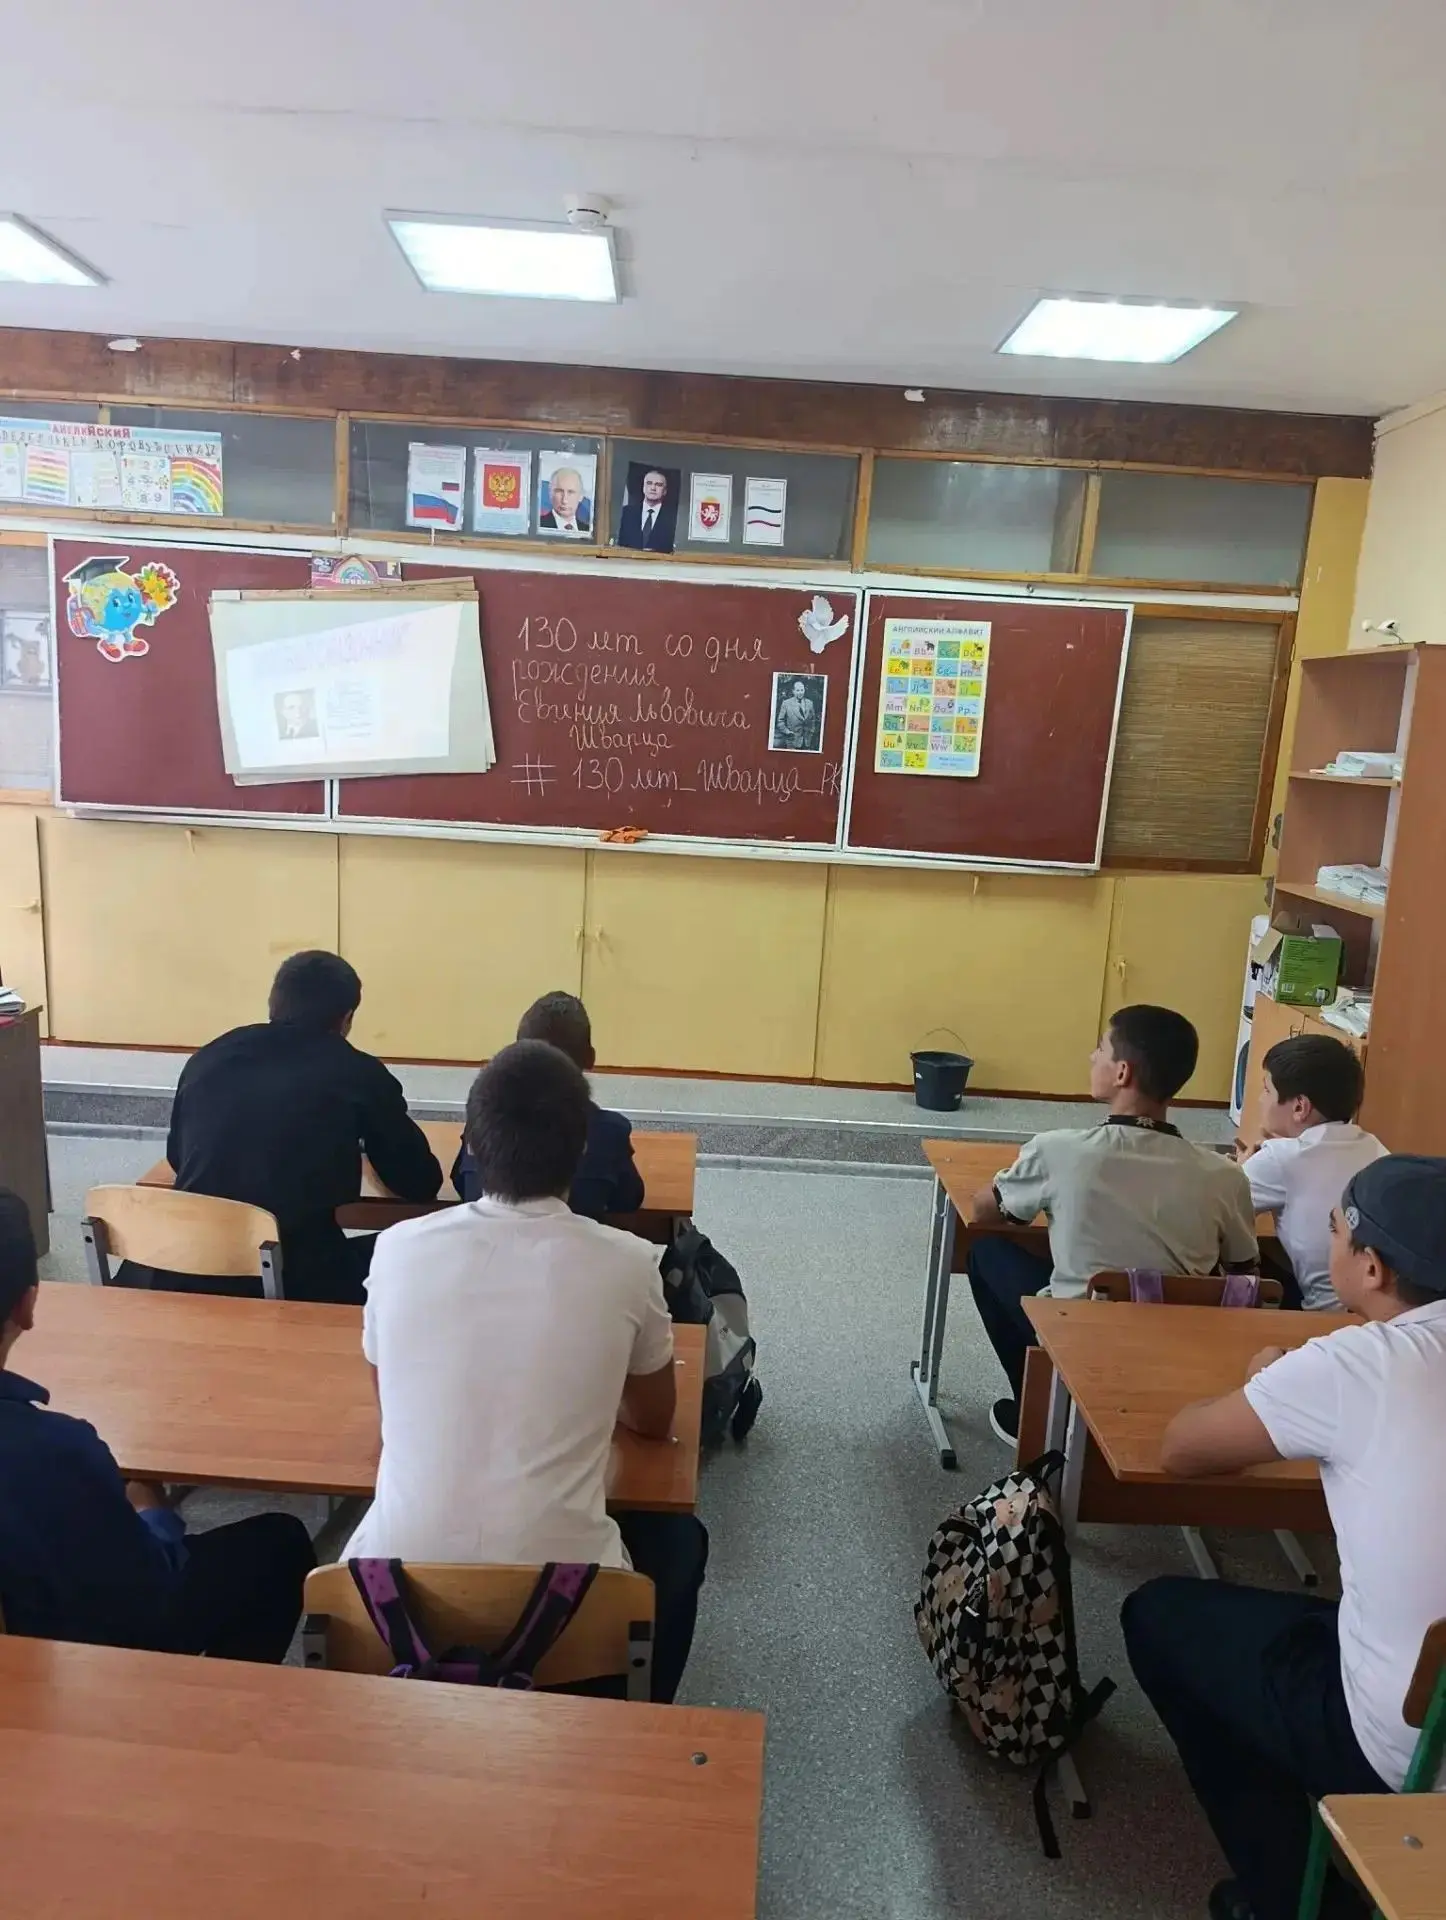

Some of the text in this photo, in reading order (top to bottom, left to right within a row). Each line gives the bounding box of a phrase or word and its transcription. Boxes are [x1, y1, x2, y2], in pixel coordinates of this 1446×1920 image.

[518, 616, 769, 673] 130 лет со дня
[512, 658, 660, 701] рождения
[518, 686, 622, 725] Евгения
[569, 722, 676, 757] Шварца
